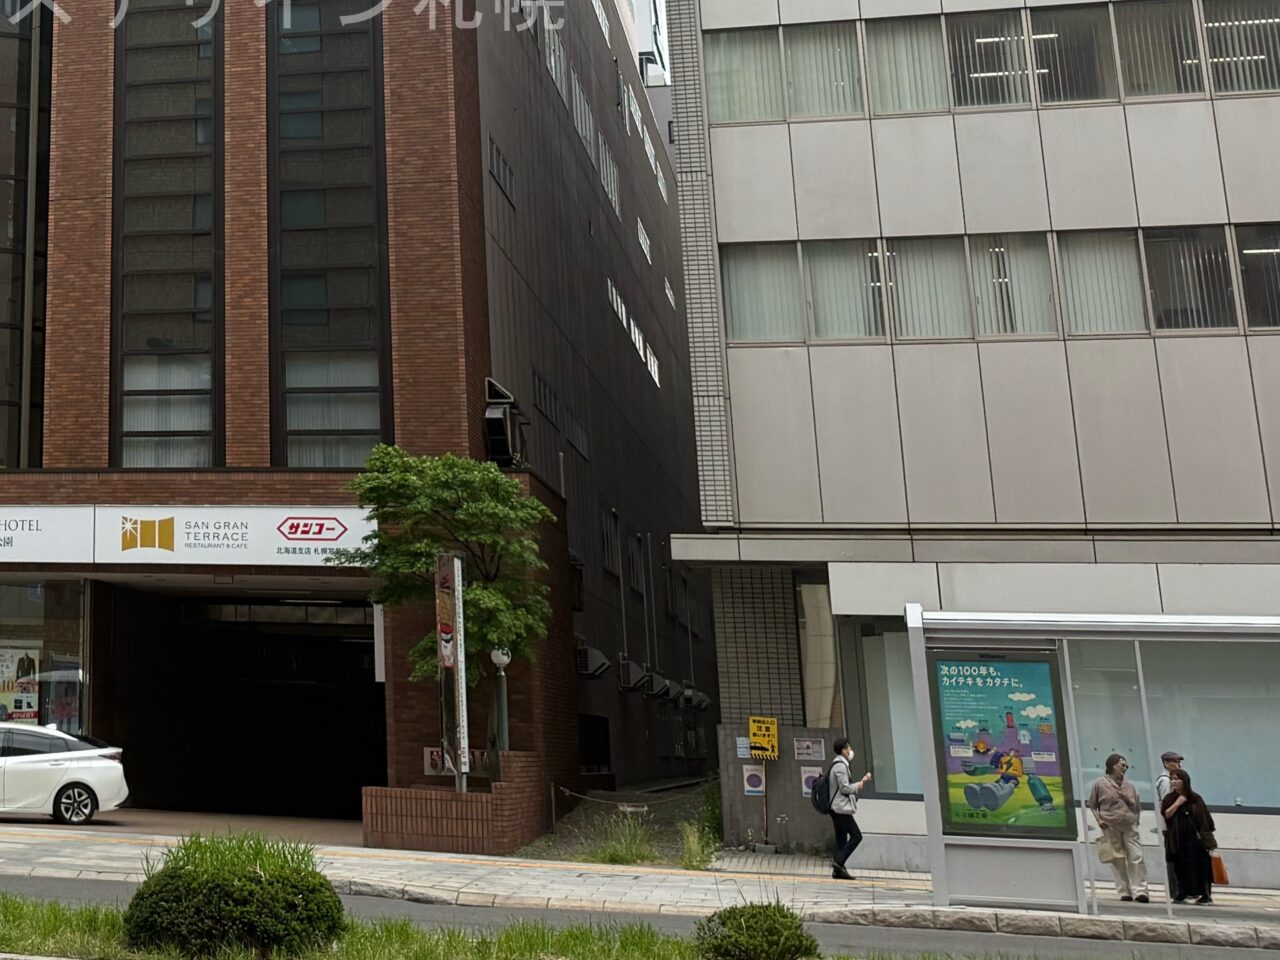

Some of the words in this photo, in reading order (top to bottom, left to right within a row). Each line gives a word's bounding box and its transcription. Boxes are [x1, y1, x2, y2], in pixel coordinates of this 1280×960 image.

[184, 521, 209, 530] SAN
[213, 521, 248, 530] GRAN
[287, 522, 336, 535] サンコー
[185, 532, 248, 541] TERRACE
[276, 546, 311, 555] 北海道支店
[940, 665, 1001, 676] 次の100年も、
